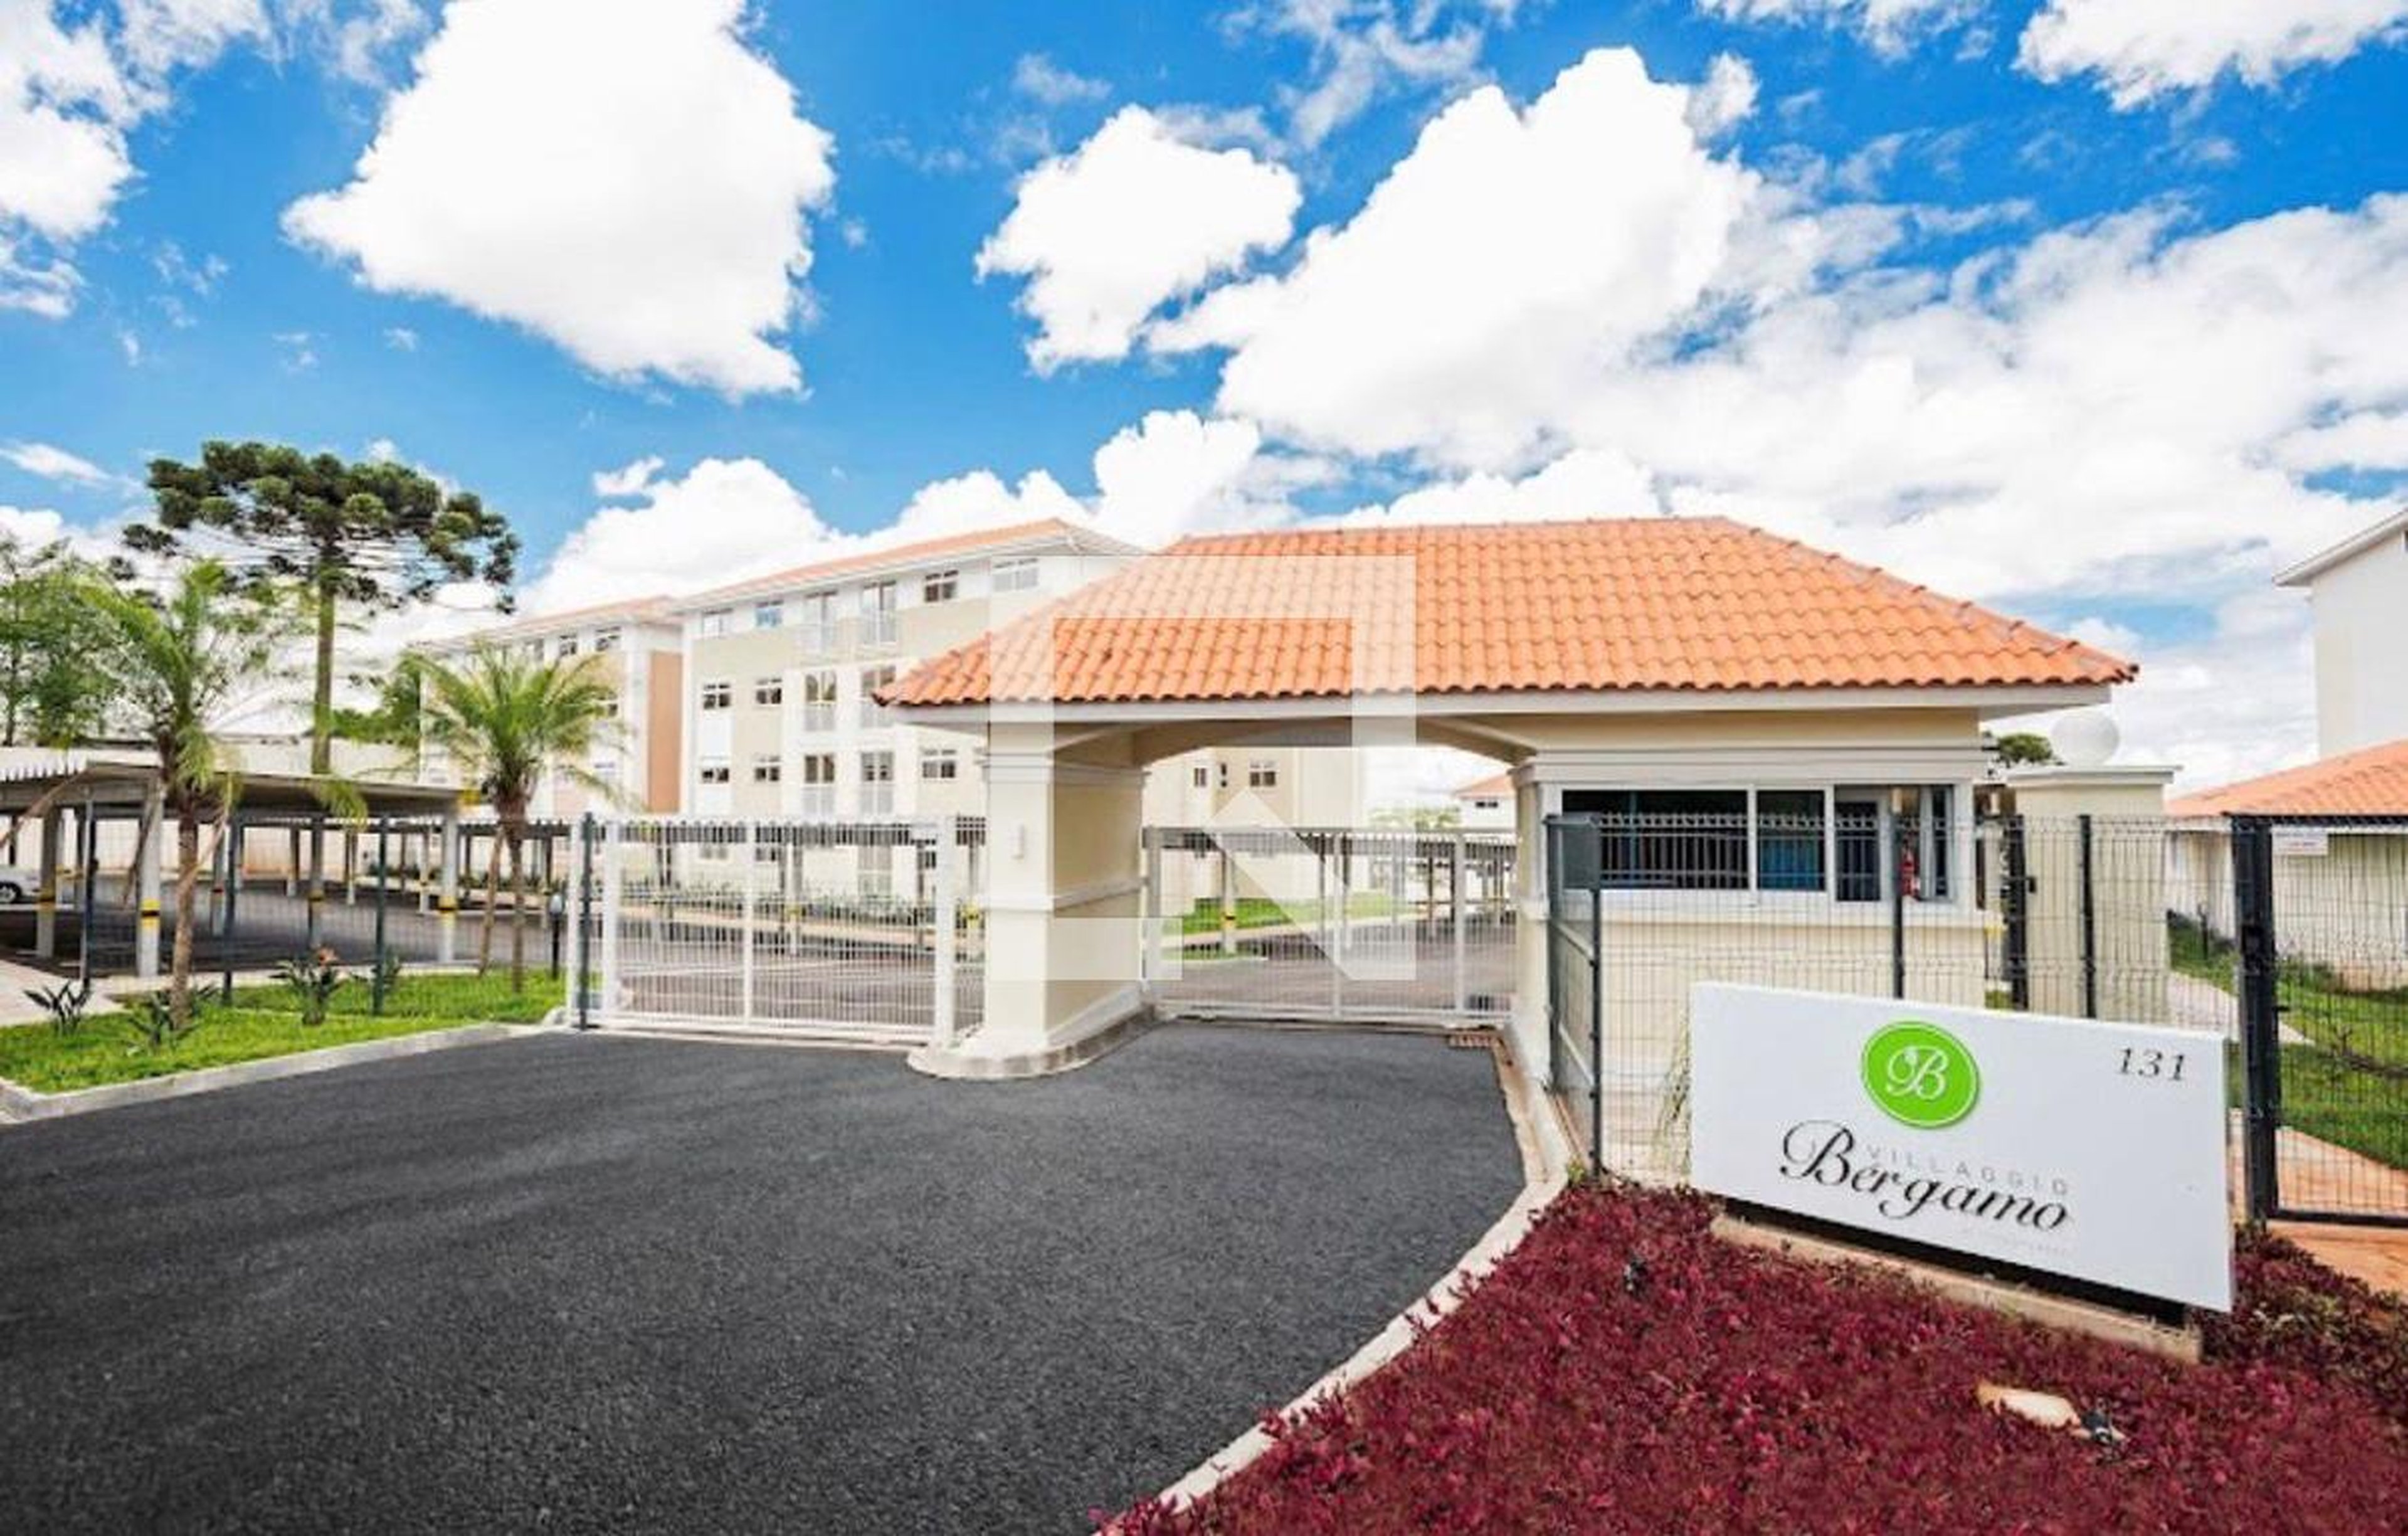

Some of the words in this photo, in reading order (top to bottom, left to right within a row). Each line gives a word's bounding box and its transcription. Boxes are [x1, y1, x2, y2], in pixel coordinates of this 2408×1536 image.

[1886, 1046, 1948, 1099] B
[2119, 1047, 2184, 1081] 131
[1780, 1120, 2072, 1231] Bergamo
